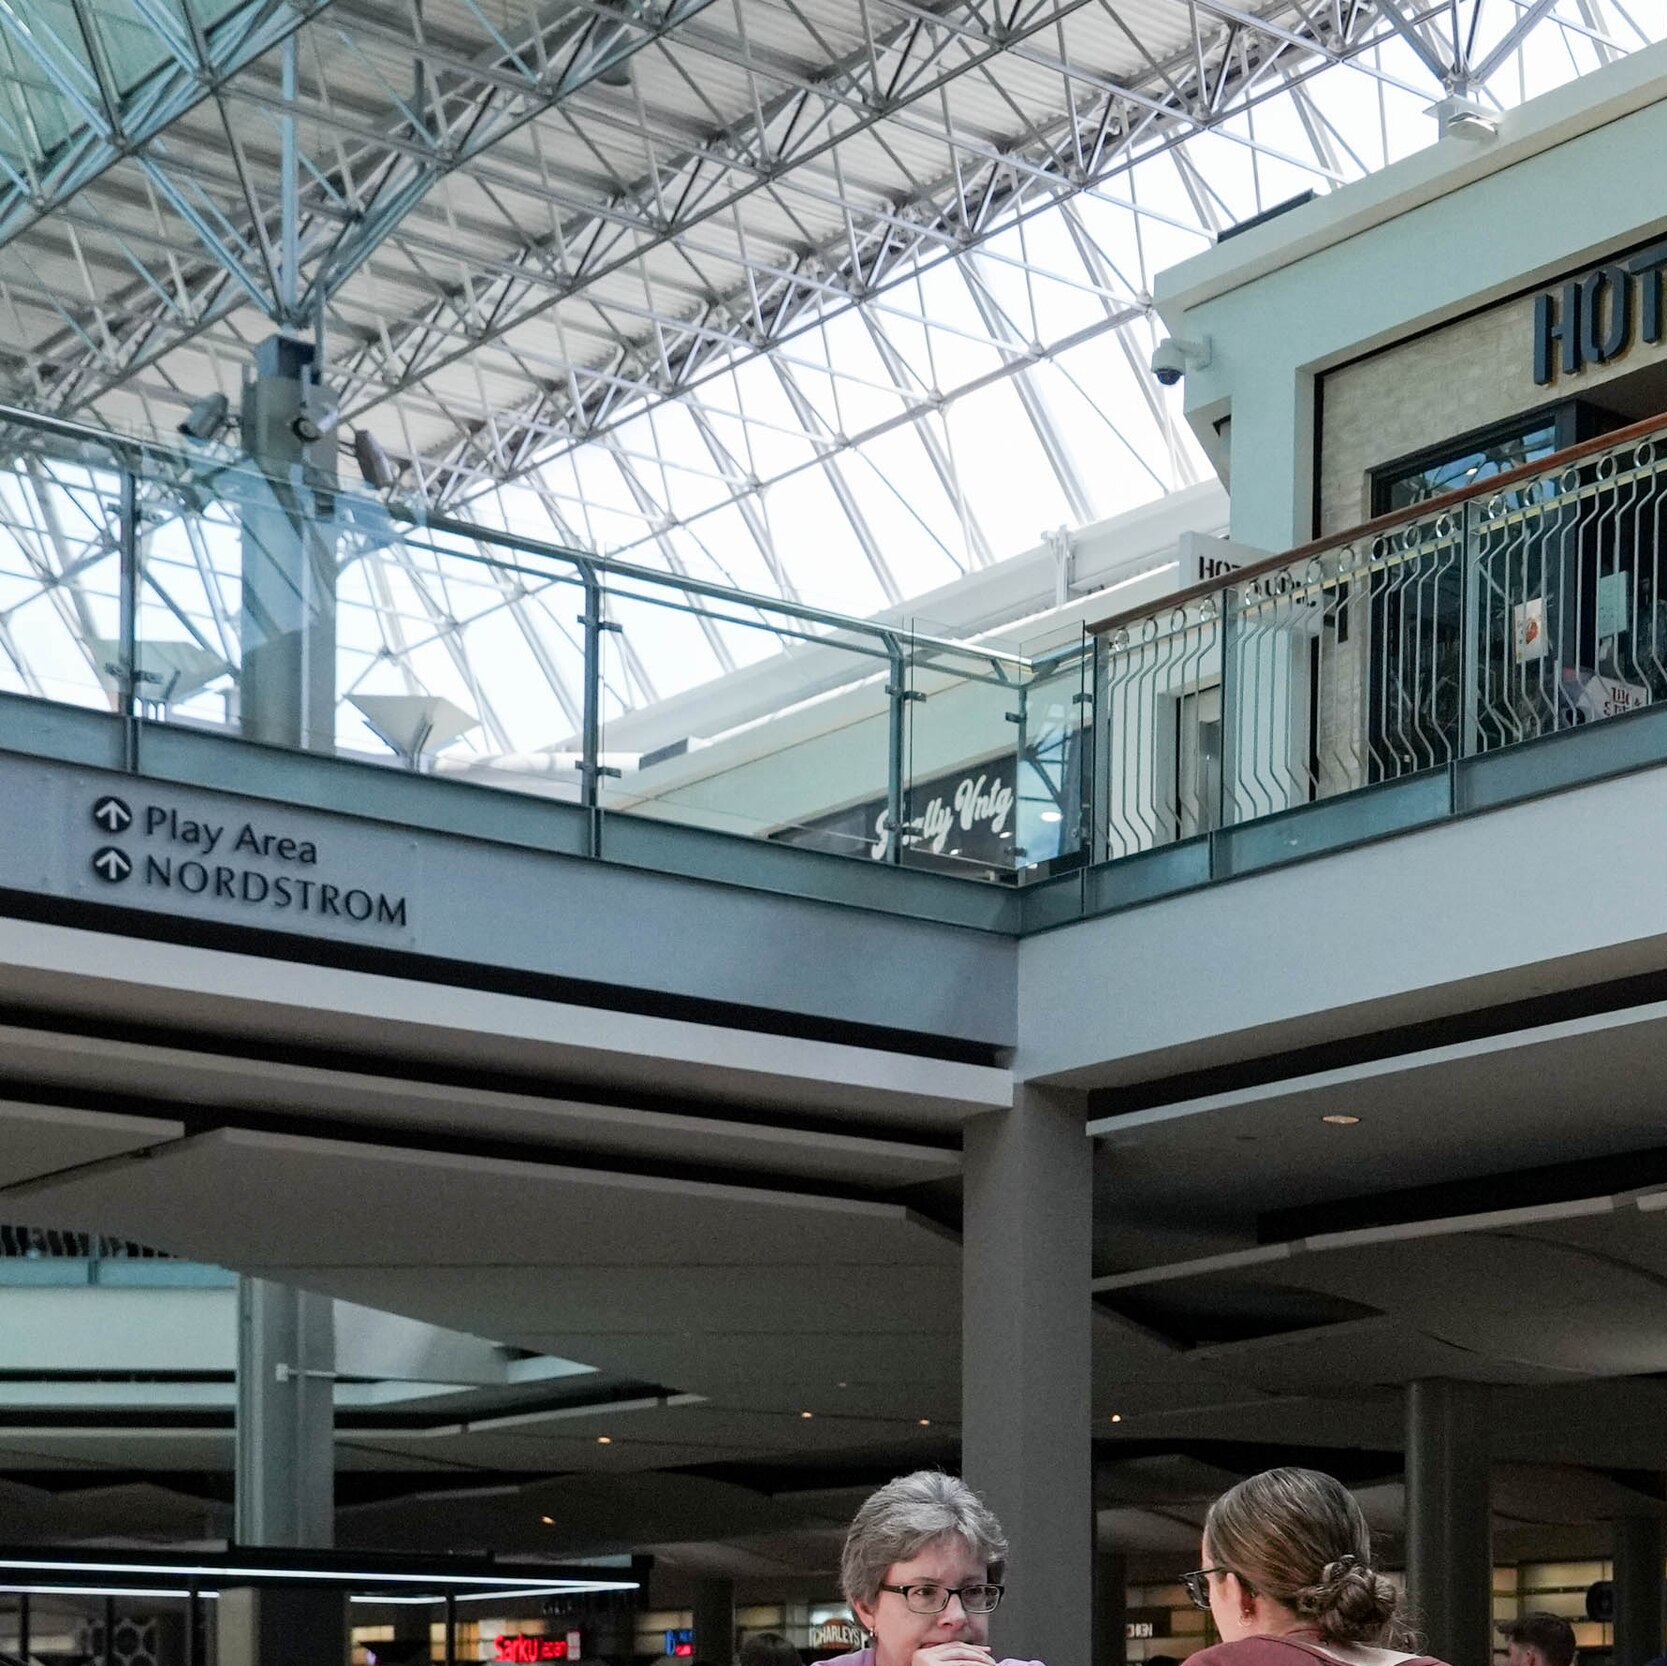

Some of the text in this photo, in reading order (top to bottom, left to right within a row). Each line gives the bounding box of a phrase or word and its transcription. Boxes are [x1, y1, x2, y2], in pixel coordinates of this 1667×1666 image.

[146, 805, 318, 864] Play Area
[871, 796, 954, 859] ally
[146, 855, 407, 927] NORDSTROM
[493, 1632, 538, 1663] Sarku
[813, 1624, 860, 1648] CHARLEYS
